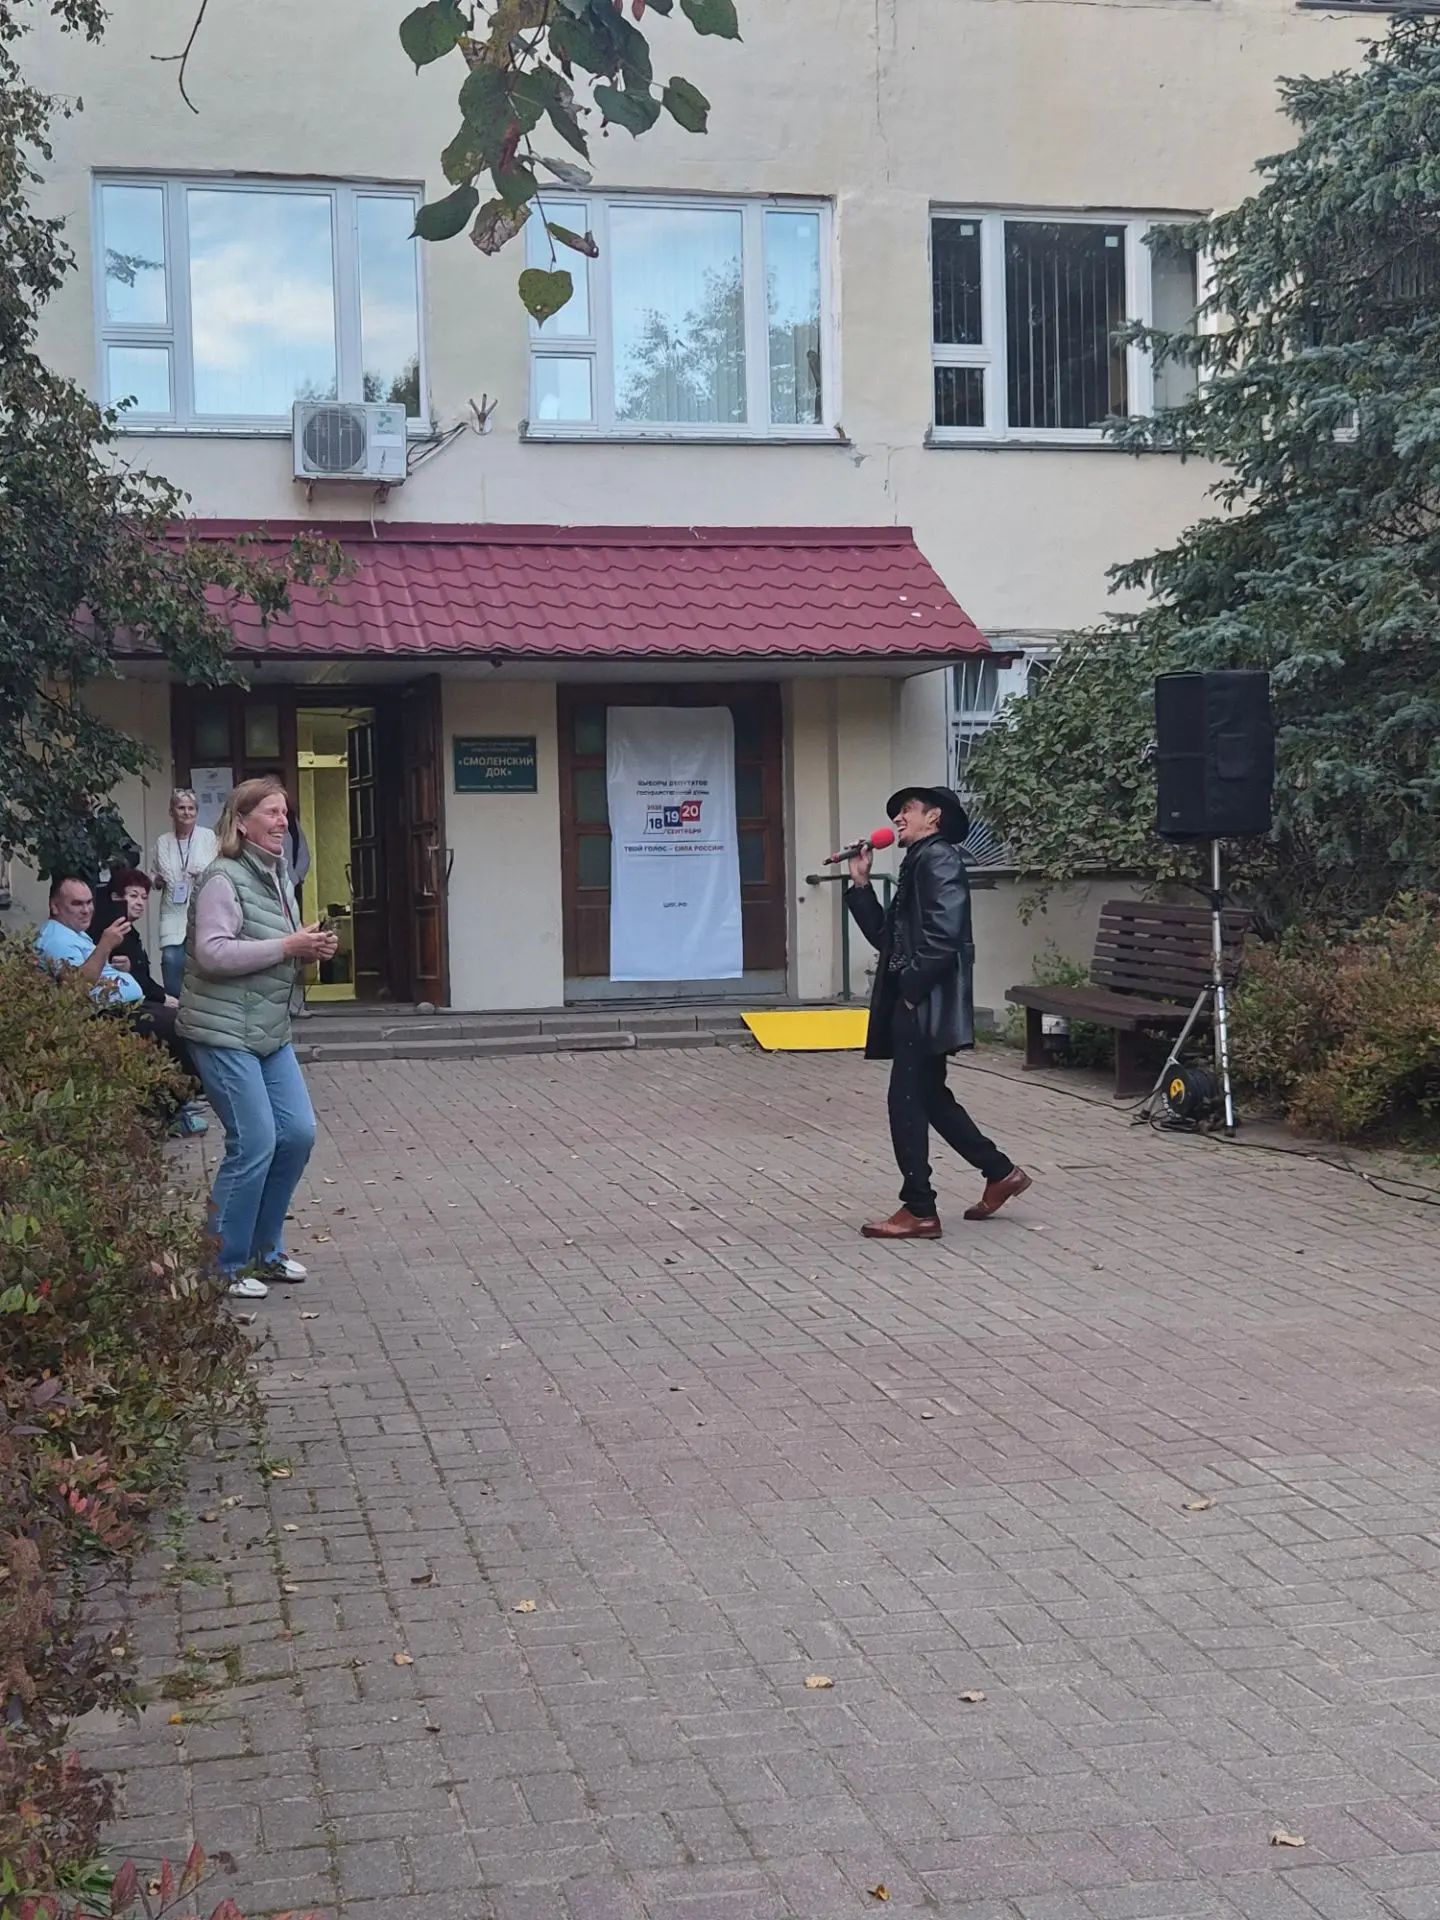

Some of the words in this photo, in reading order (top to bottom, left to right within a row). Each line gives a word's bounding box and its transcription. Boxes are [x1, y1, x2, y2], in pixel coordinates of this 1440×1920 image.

[649, 818, 663, 829] 18
[665, 811, 679, 823] 19
[682, 805, 699, 817] 20
[624, 844, 643, 852] ТВОЙ
